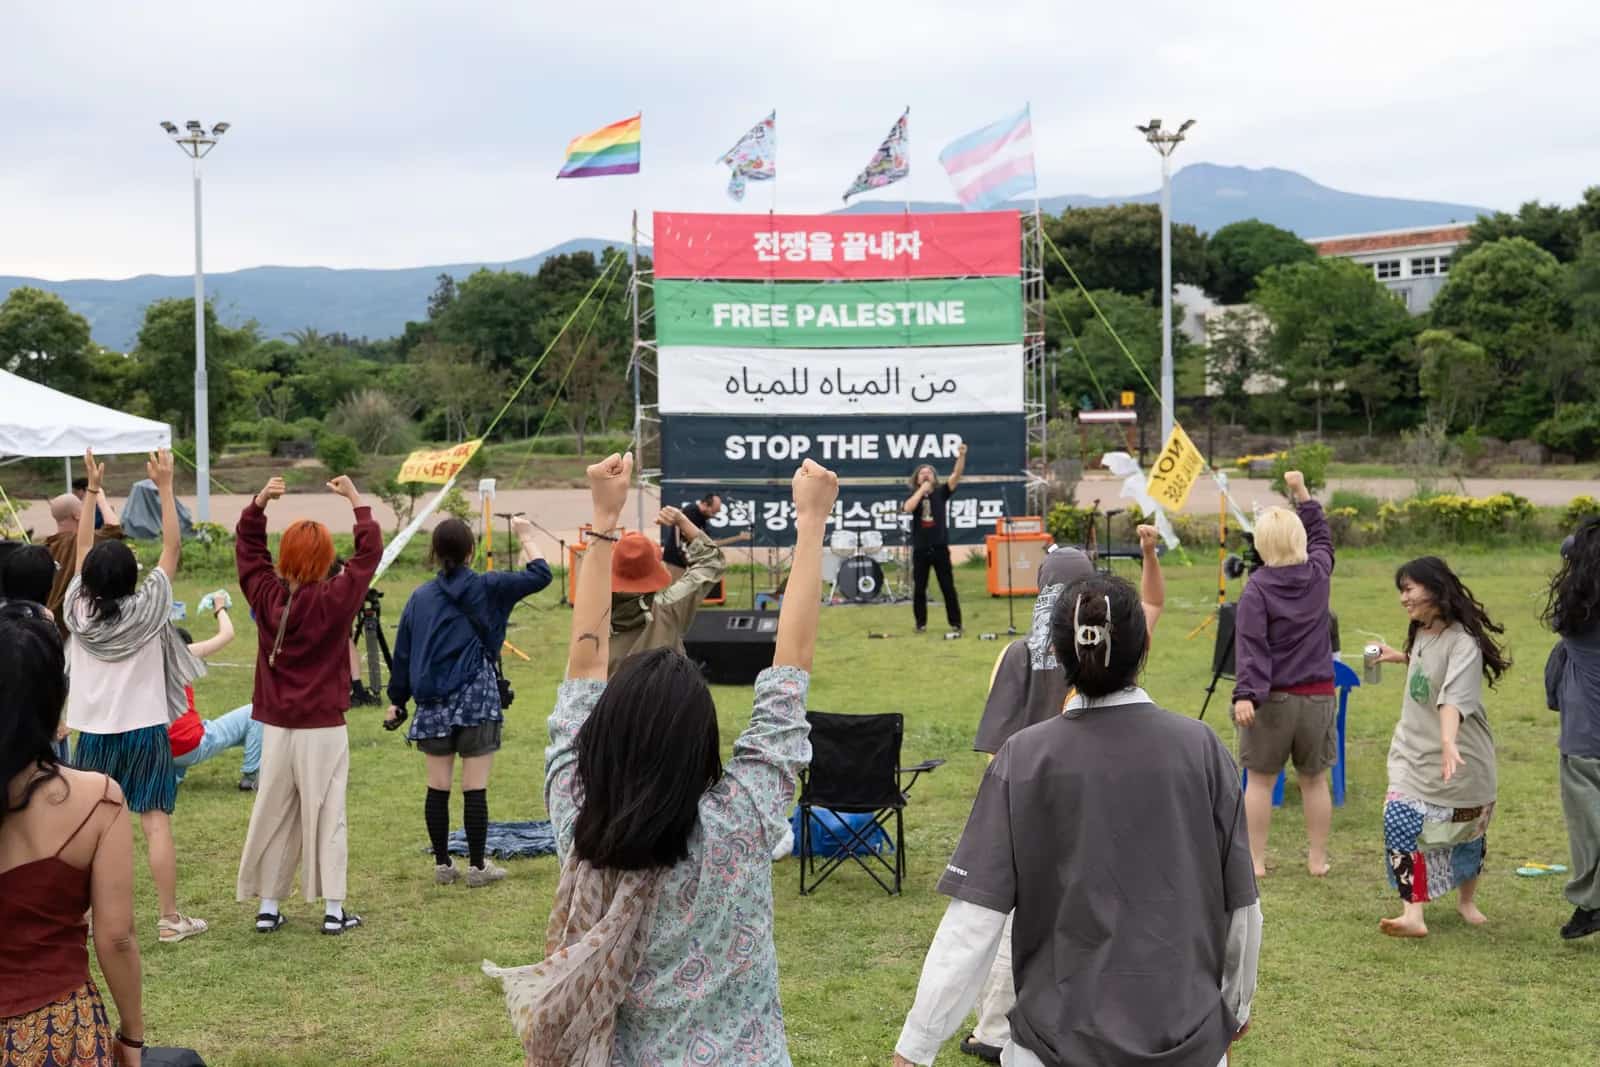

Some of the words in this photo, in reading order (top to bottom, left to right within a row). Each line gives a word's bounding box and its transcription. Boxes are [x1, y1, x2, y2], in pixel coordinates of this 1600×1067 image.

[753, 231, 834, 261] 전쟁을
[841, 230, 922, 261] 끝내자
[712, 303, 789, 327] FREE
[795, 301, 966, 327] PALESTINE
[726, 366, 808, 402] للمياه
[820, 367, 900, 402] المياه
[911, 374, 957, 402] من
[725, 435, 810, 460] STOP
[817, 434, 879, 459] THE
[886, 433, 963, 459] WAR
[682, 499, 755, 527] 3회
[763, 498, 1003, 531] 강스앤캠프
